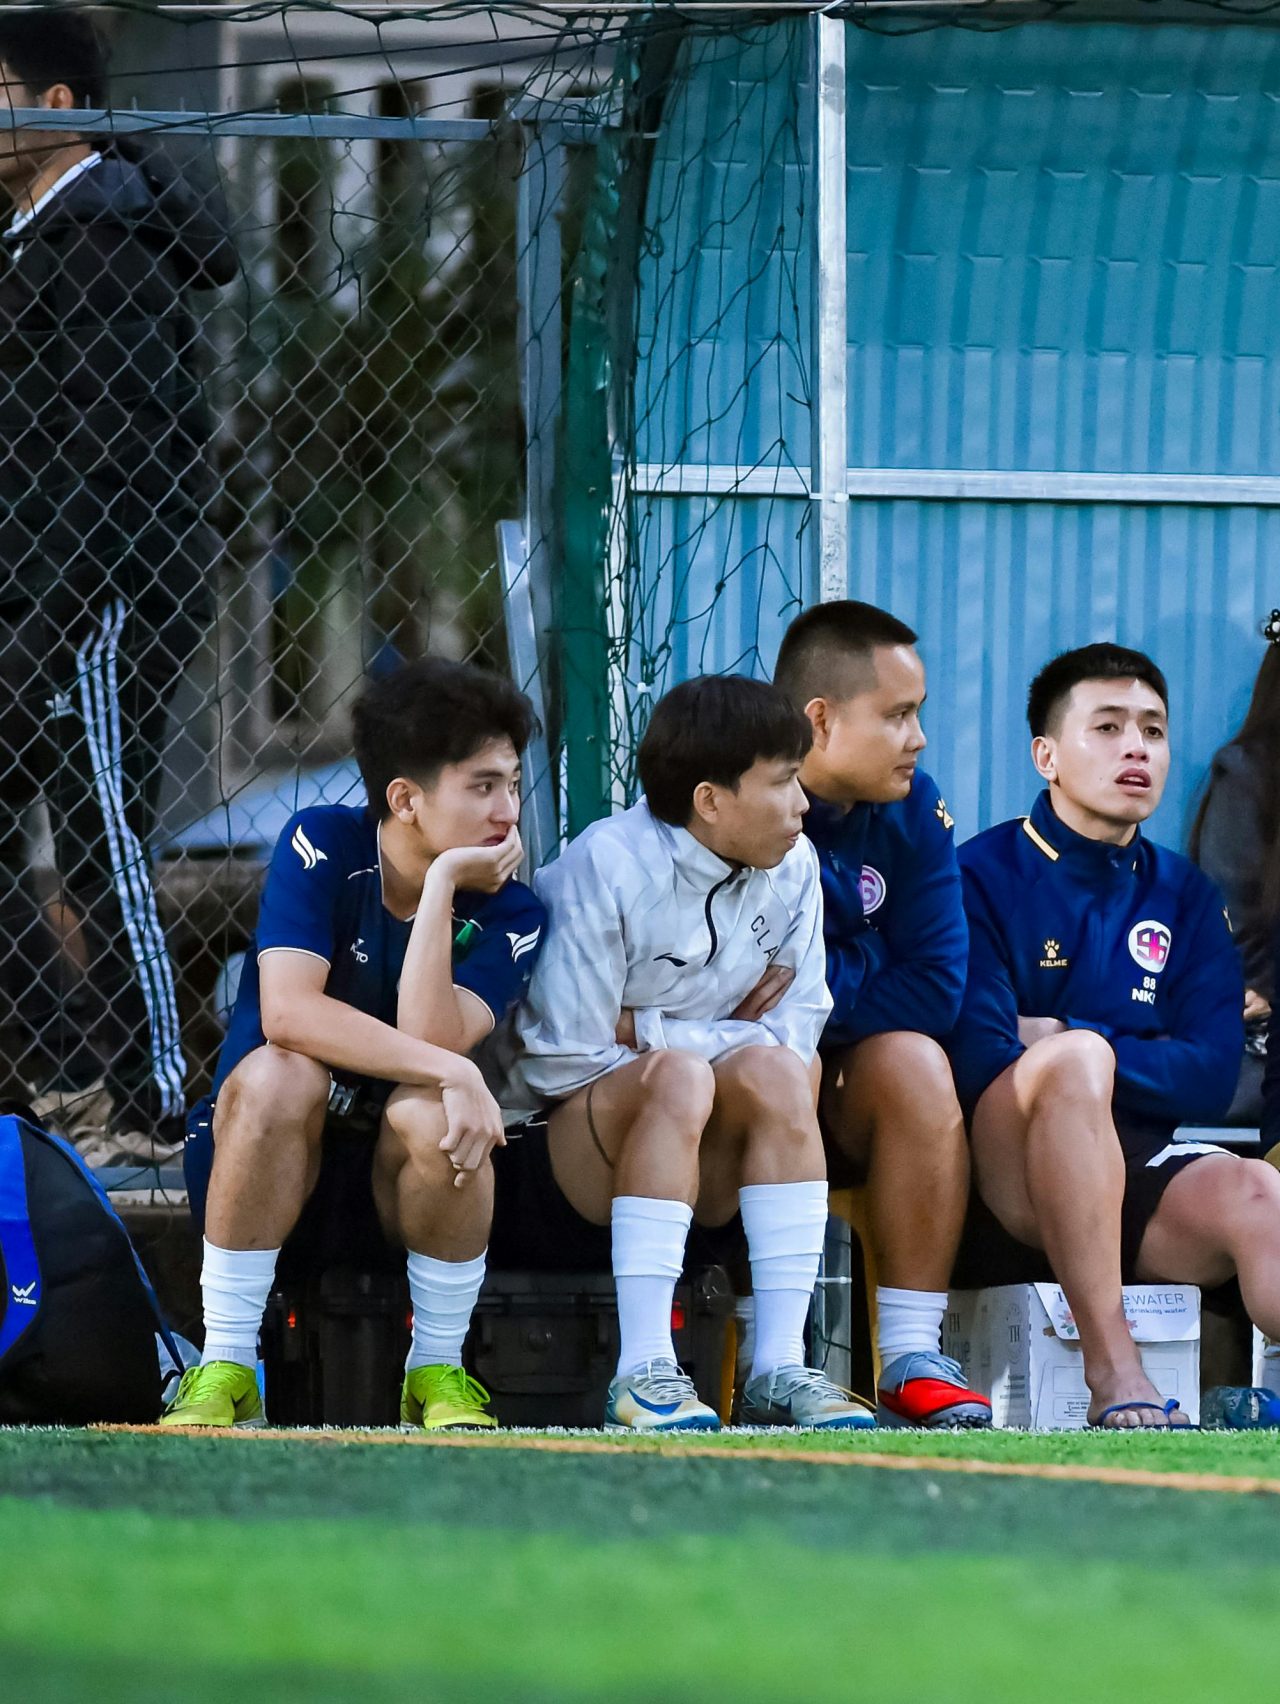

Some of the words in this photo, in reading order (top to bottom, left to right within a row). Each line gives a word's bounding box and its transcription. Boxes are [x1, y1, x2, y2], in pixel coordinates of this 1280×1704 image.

[1040, 959, 1068, 967] KELME
[1143, 976, 1156, 990] 88
[1135, 1292, 1184, 1305] WATER
[1129, 1307, 1162, 1315] drinking
